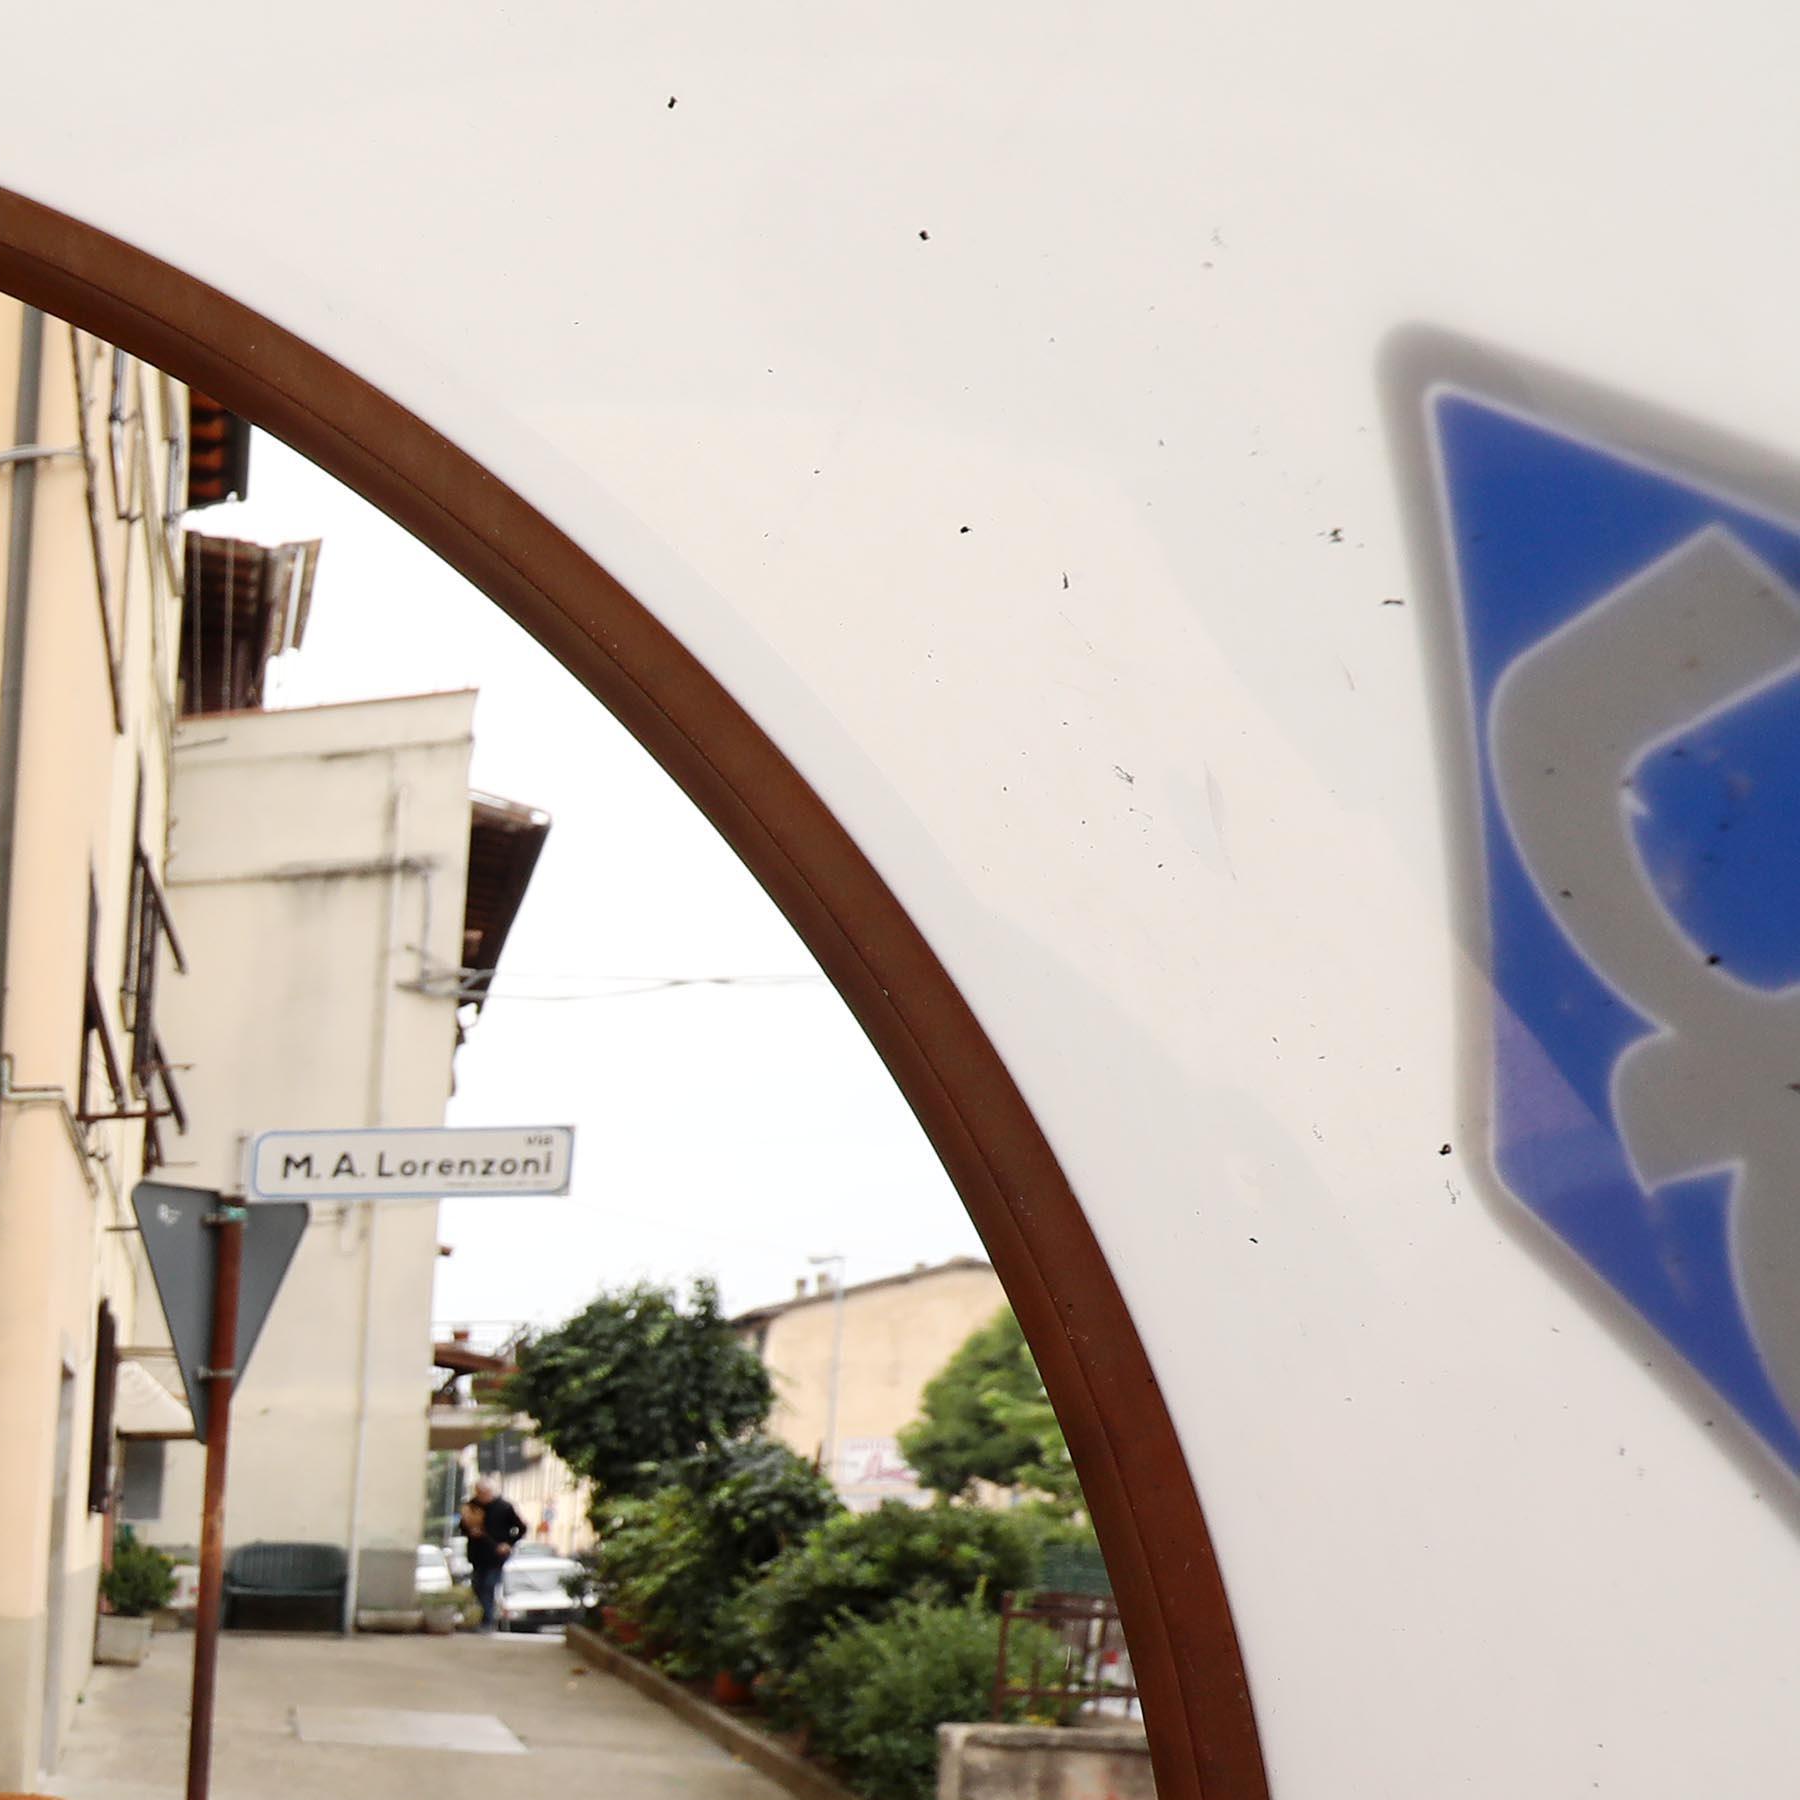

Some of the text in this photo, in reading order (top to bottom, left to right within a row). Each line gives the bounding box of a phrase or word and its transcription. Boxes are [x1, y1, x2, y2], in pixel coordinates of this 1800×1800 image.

[282, 1150, 553, 1179] M. A. Lorenzoni
